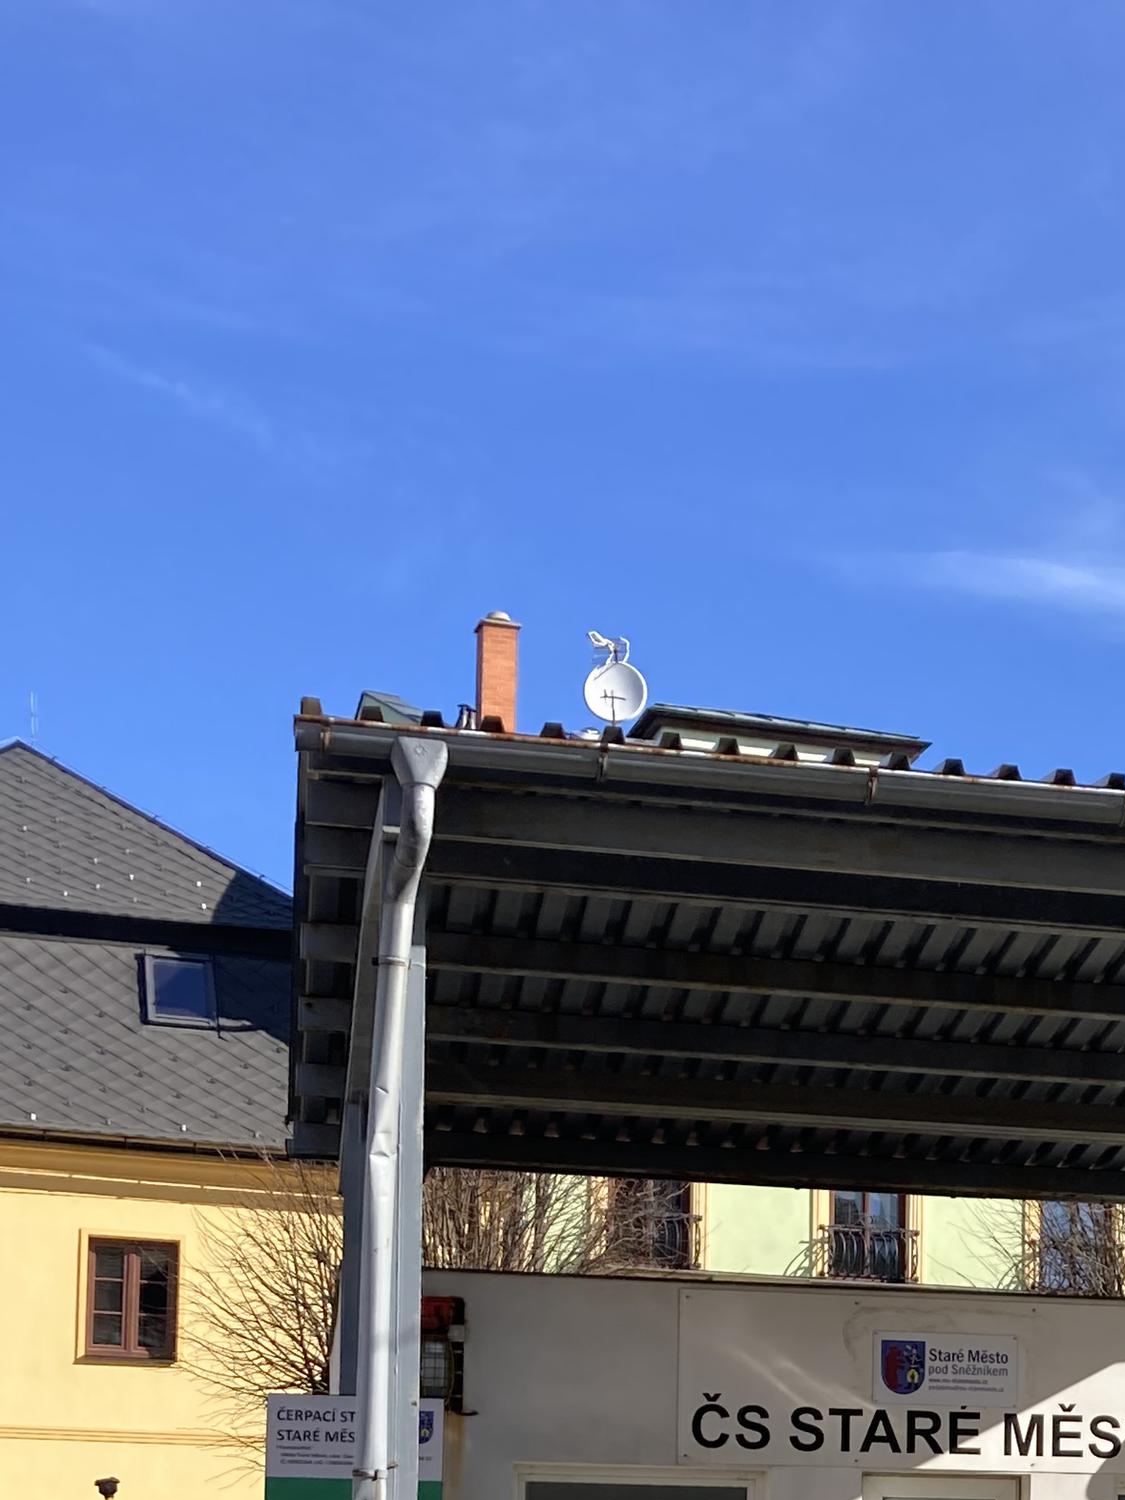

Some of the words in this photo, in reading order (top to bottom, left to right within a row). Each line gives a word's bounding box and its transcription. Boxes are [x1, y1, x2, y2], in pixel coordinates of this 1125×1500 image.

[929, 1348, 965, 1363] Staré
[968, 1349, 1009, 1364] Město
[928, 1364, 949, 1376] pod
[276, 1406, 337, 1422] ČERPACÍ
[340, 1410, 356, 1423] ST
[691, 1392, 771, 1450] ČS
[789, 1405, 981, 1456] STARÉ
[276, 1427, 321, 1442] STARÉ
[325, 1428, 356, 1443] MĚS
